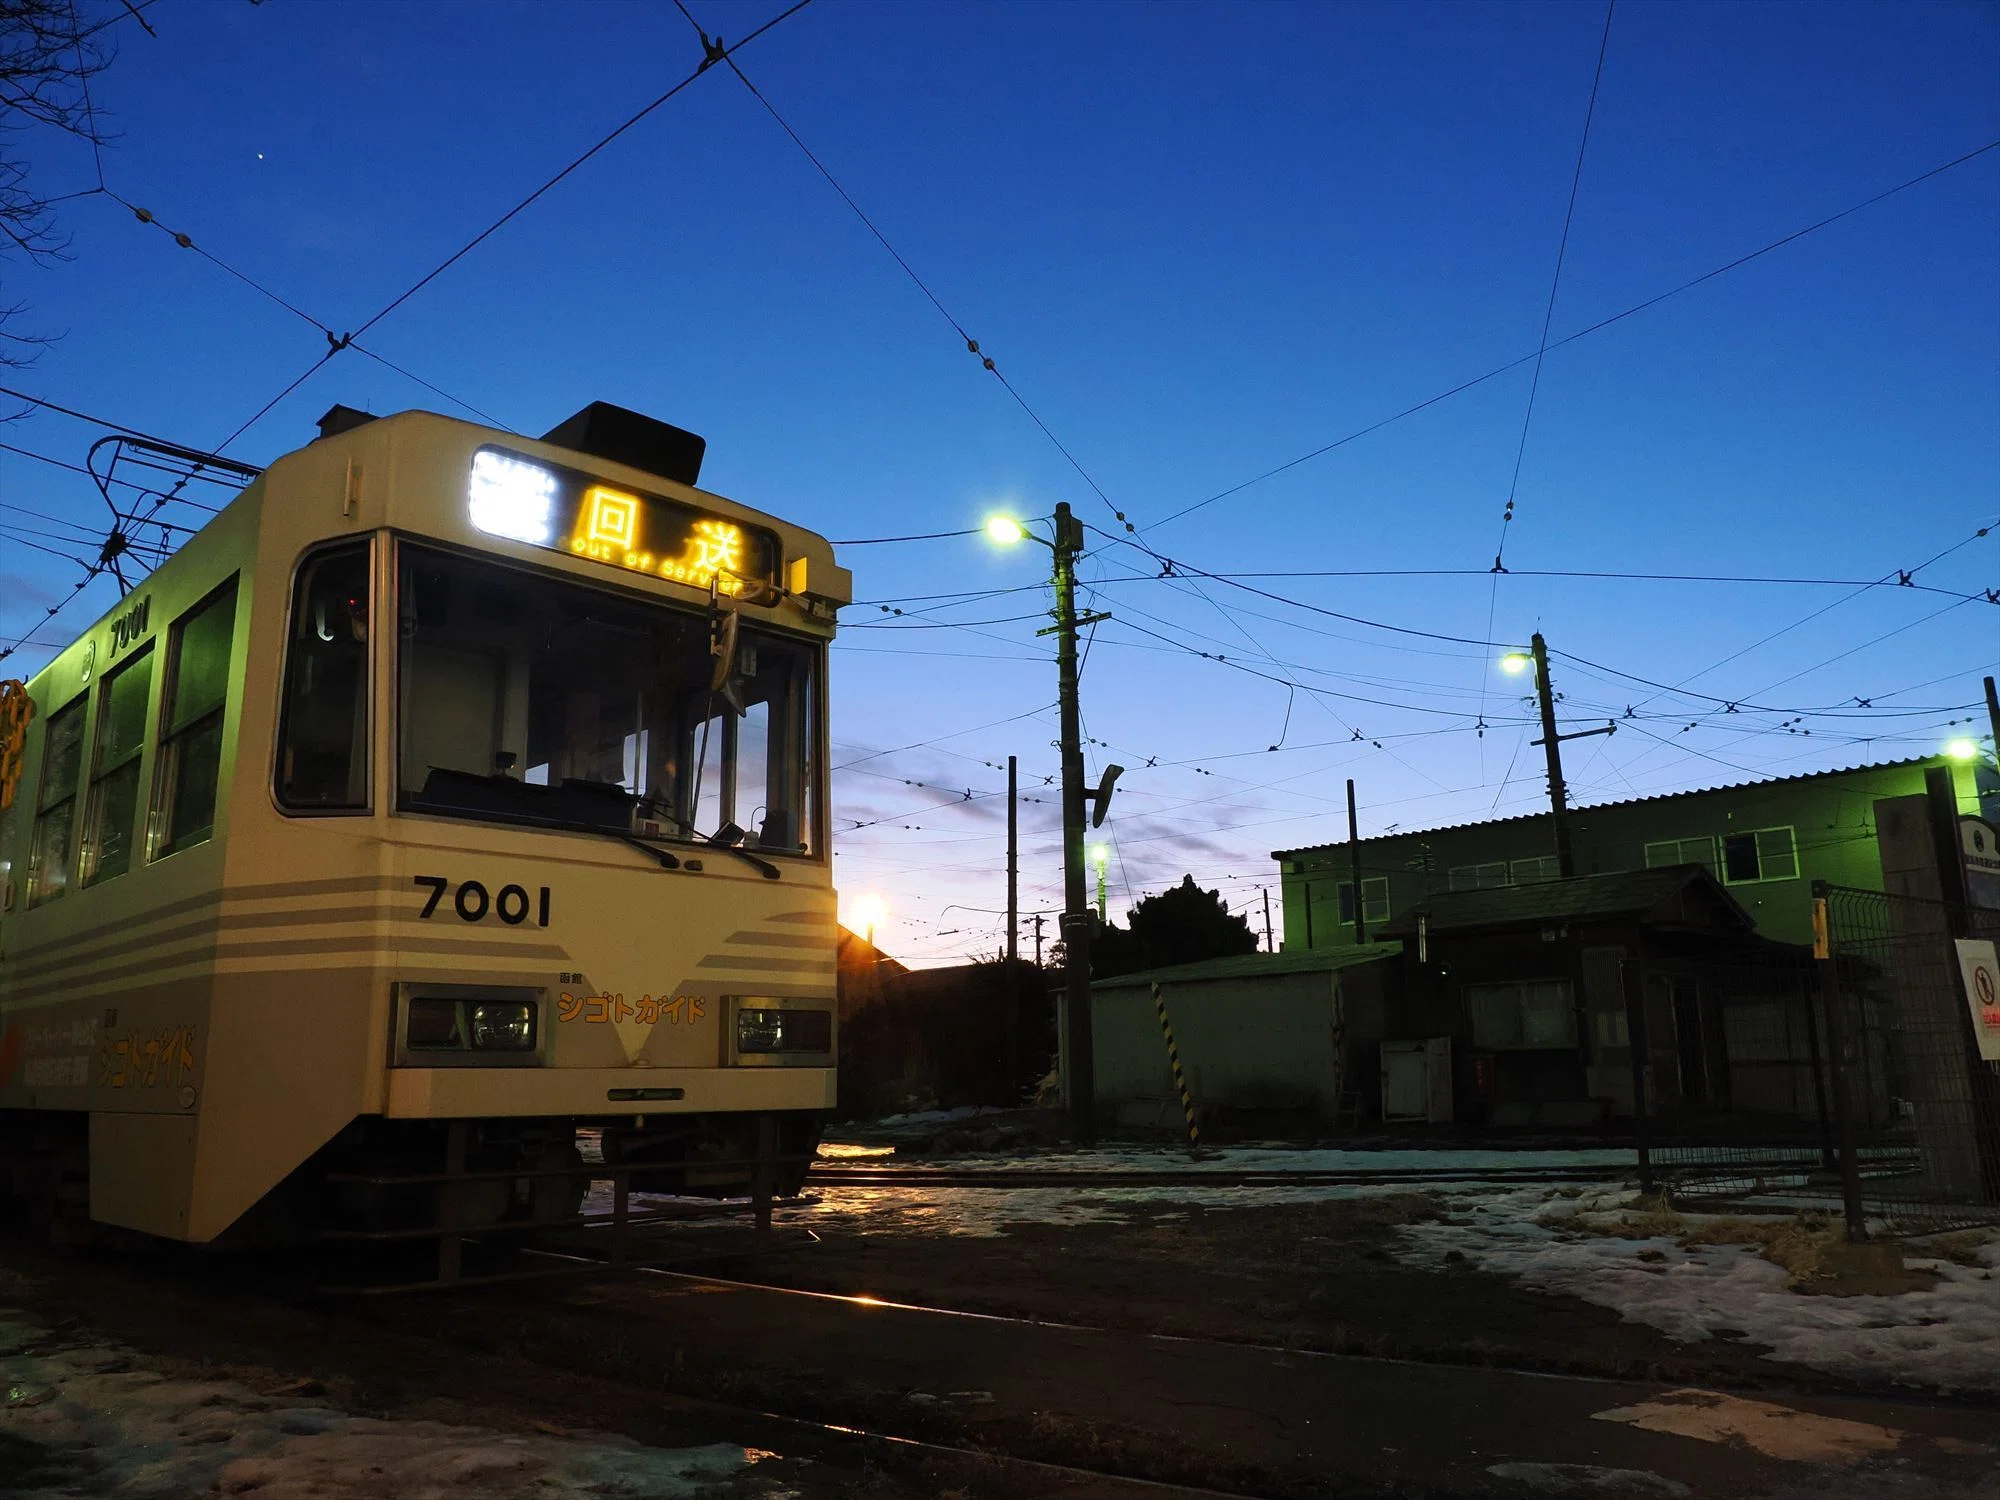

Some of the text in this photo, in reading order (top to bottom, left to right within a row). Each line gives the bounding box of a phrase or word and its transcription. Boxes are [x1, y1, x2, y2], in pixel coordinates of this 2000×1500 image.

[588, 488, 741, 573] 回送
[573, 536, 612, 561] Out
[661, 559, 743, 593] Servce
[110, 594, 151, 659] 7001
[413, 875, 551, 928] 7001
[559, 972, 583, 985] 函館
[557, 991, 706, 1025] シゴトガイド
